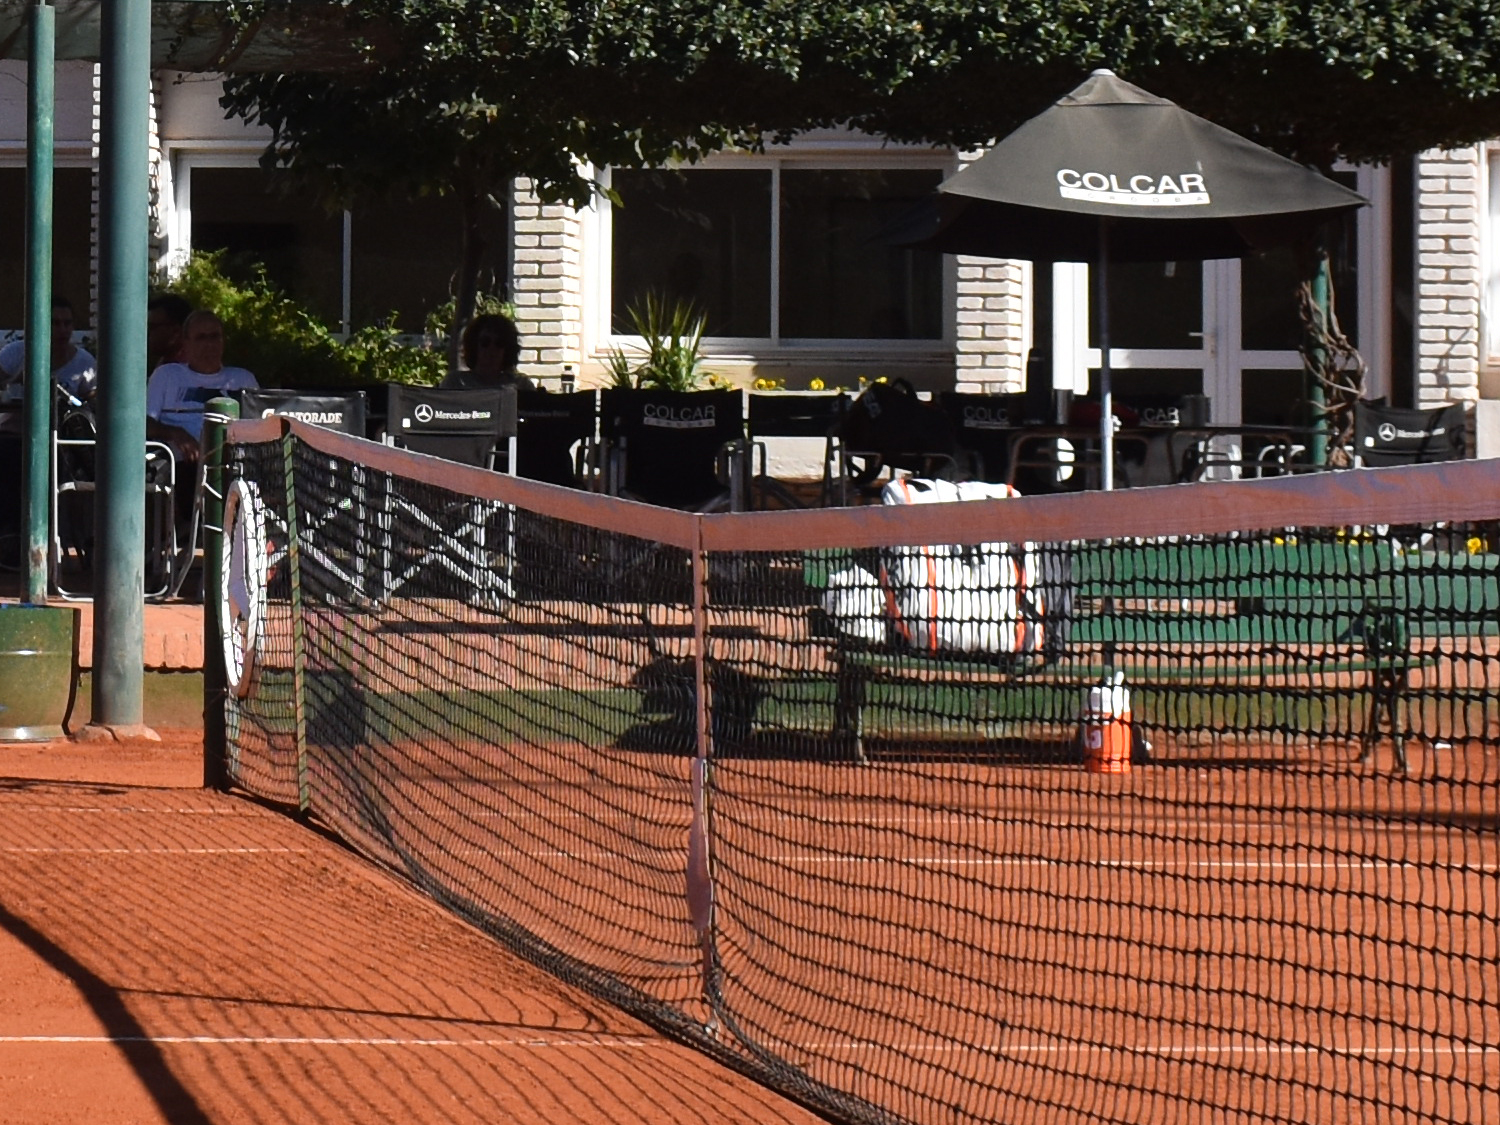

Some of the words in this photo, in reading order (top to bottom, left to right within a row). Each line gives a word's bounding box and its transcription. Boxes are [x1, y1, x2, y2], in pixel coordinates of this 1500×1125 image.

[1056, 168, 1207, 194] COLCAR
[280, 411, 343, 424] TORADE
[644, 403, 716, 420] COLCAR
[963, 405, 1010, 422] COLC
[1143, 407, 1179, 422] CAR
